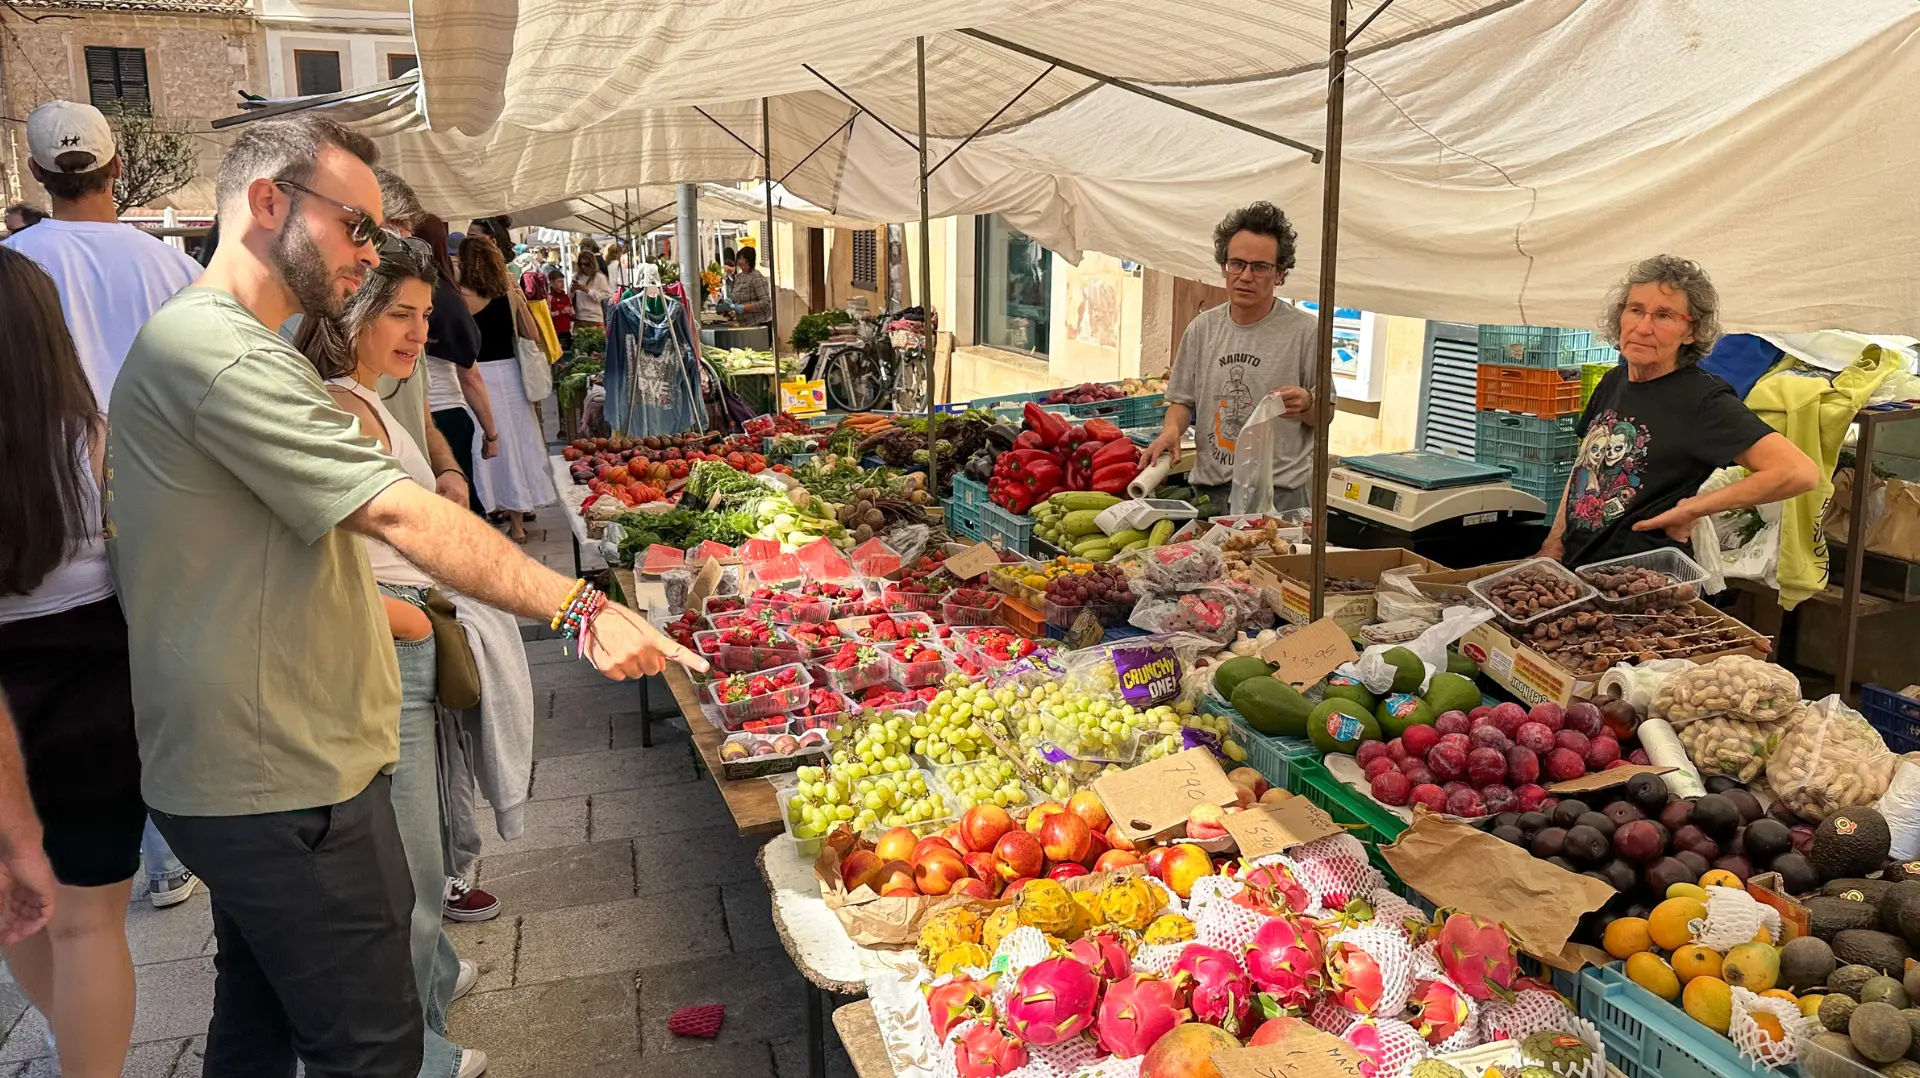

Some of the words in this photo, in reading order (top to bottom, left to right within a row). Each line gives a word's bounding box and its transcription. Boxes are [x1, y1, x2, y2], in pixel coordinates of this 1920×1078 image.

[1218, 352, 1261, 368] NARUTO
[1122, 656, 1175, 690] CRUNCHY
[1148, 675, 1177, 699] ONE!
[1509, 676, 1531, 700] Nour
